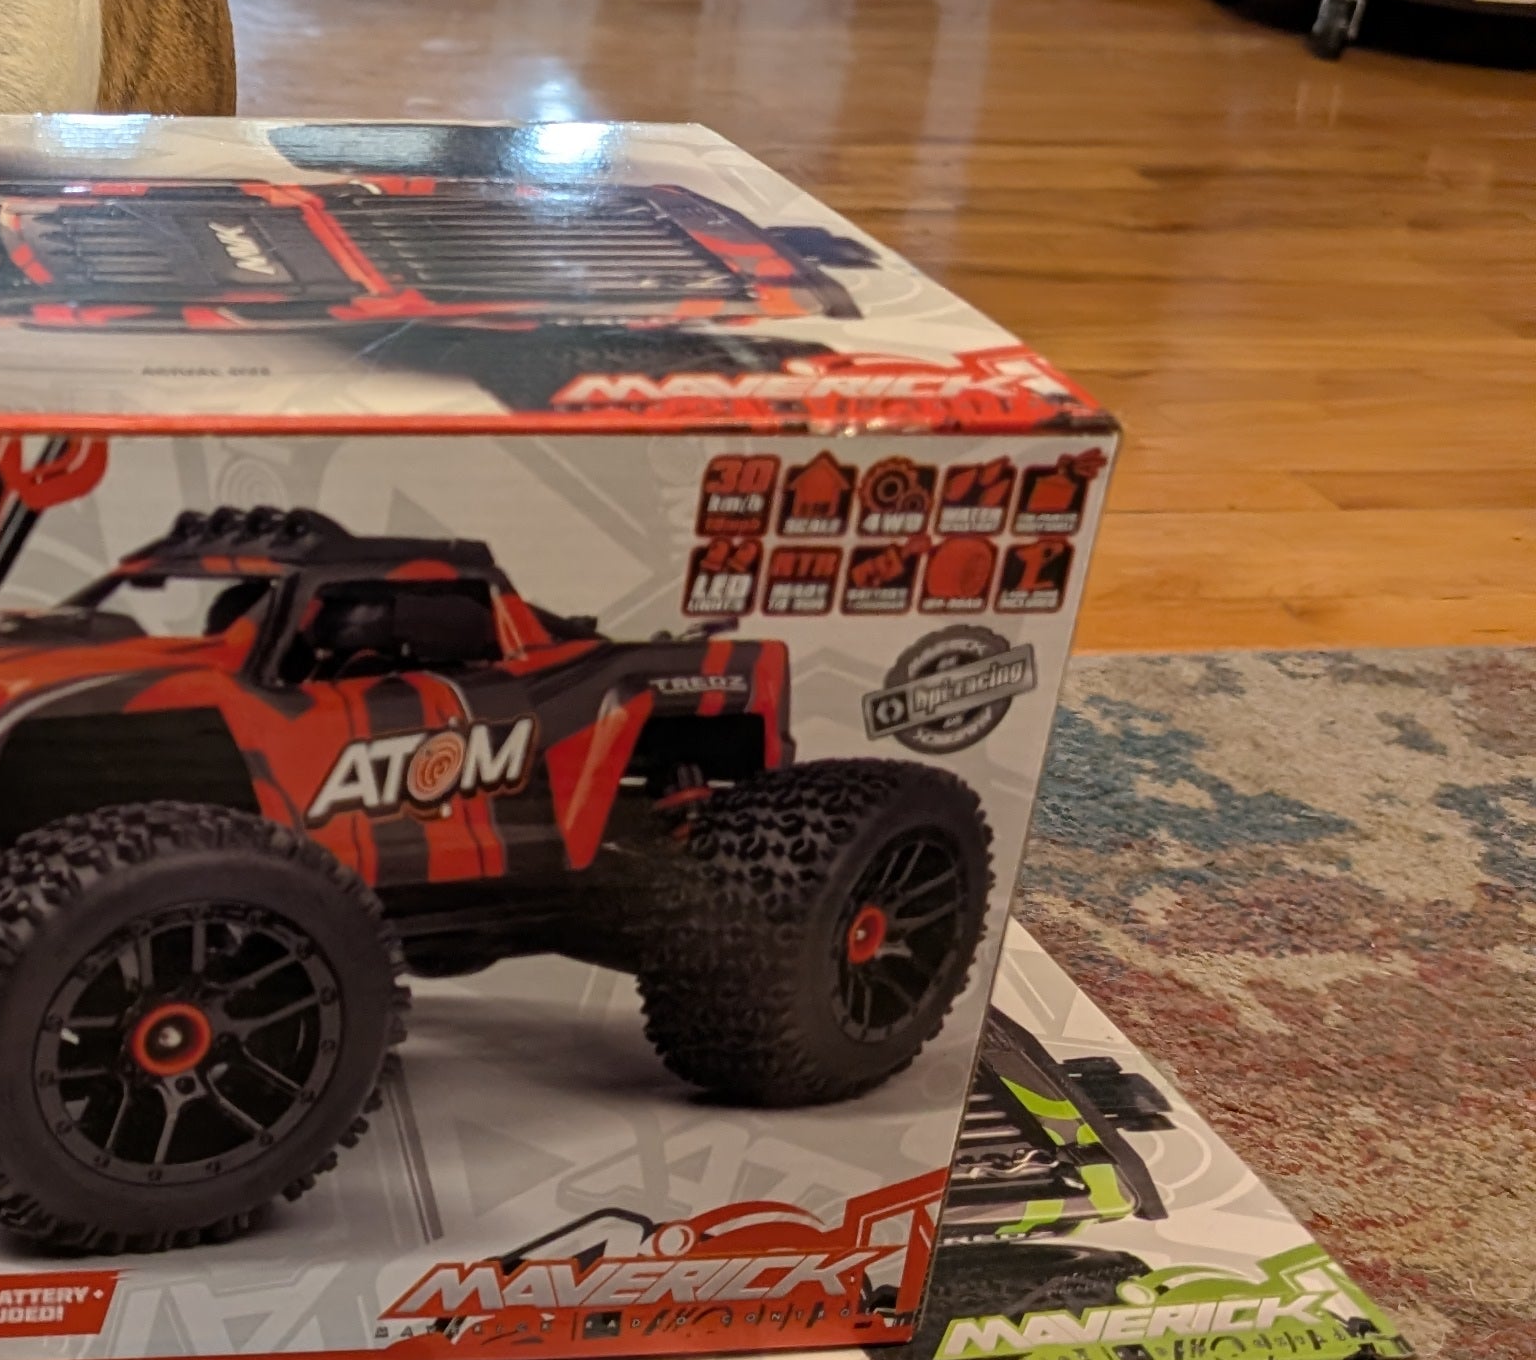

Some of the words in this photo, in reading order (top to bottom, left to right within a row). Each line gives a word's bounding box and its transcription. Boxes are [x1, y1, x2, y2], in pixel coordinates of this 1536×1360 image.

[562, 374, 1020, 399] MAVERICK
[690, 573, 753, 599] LED
[307, 718, 533, 819] ATOM
[400, 1251, 878, 1312] MAVERICK
[944, 1294, 1323, 1356] MAVERICK
